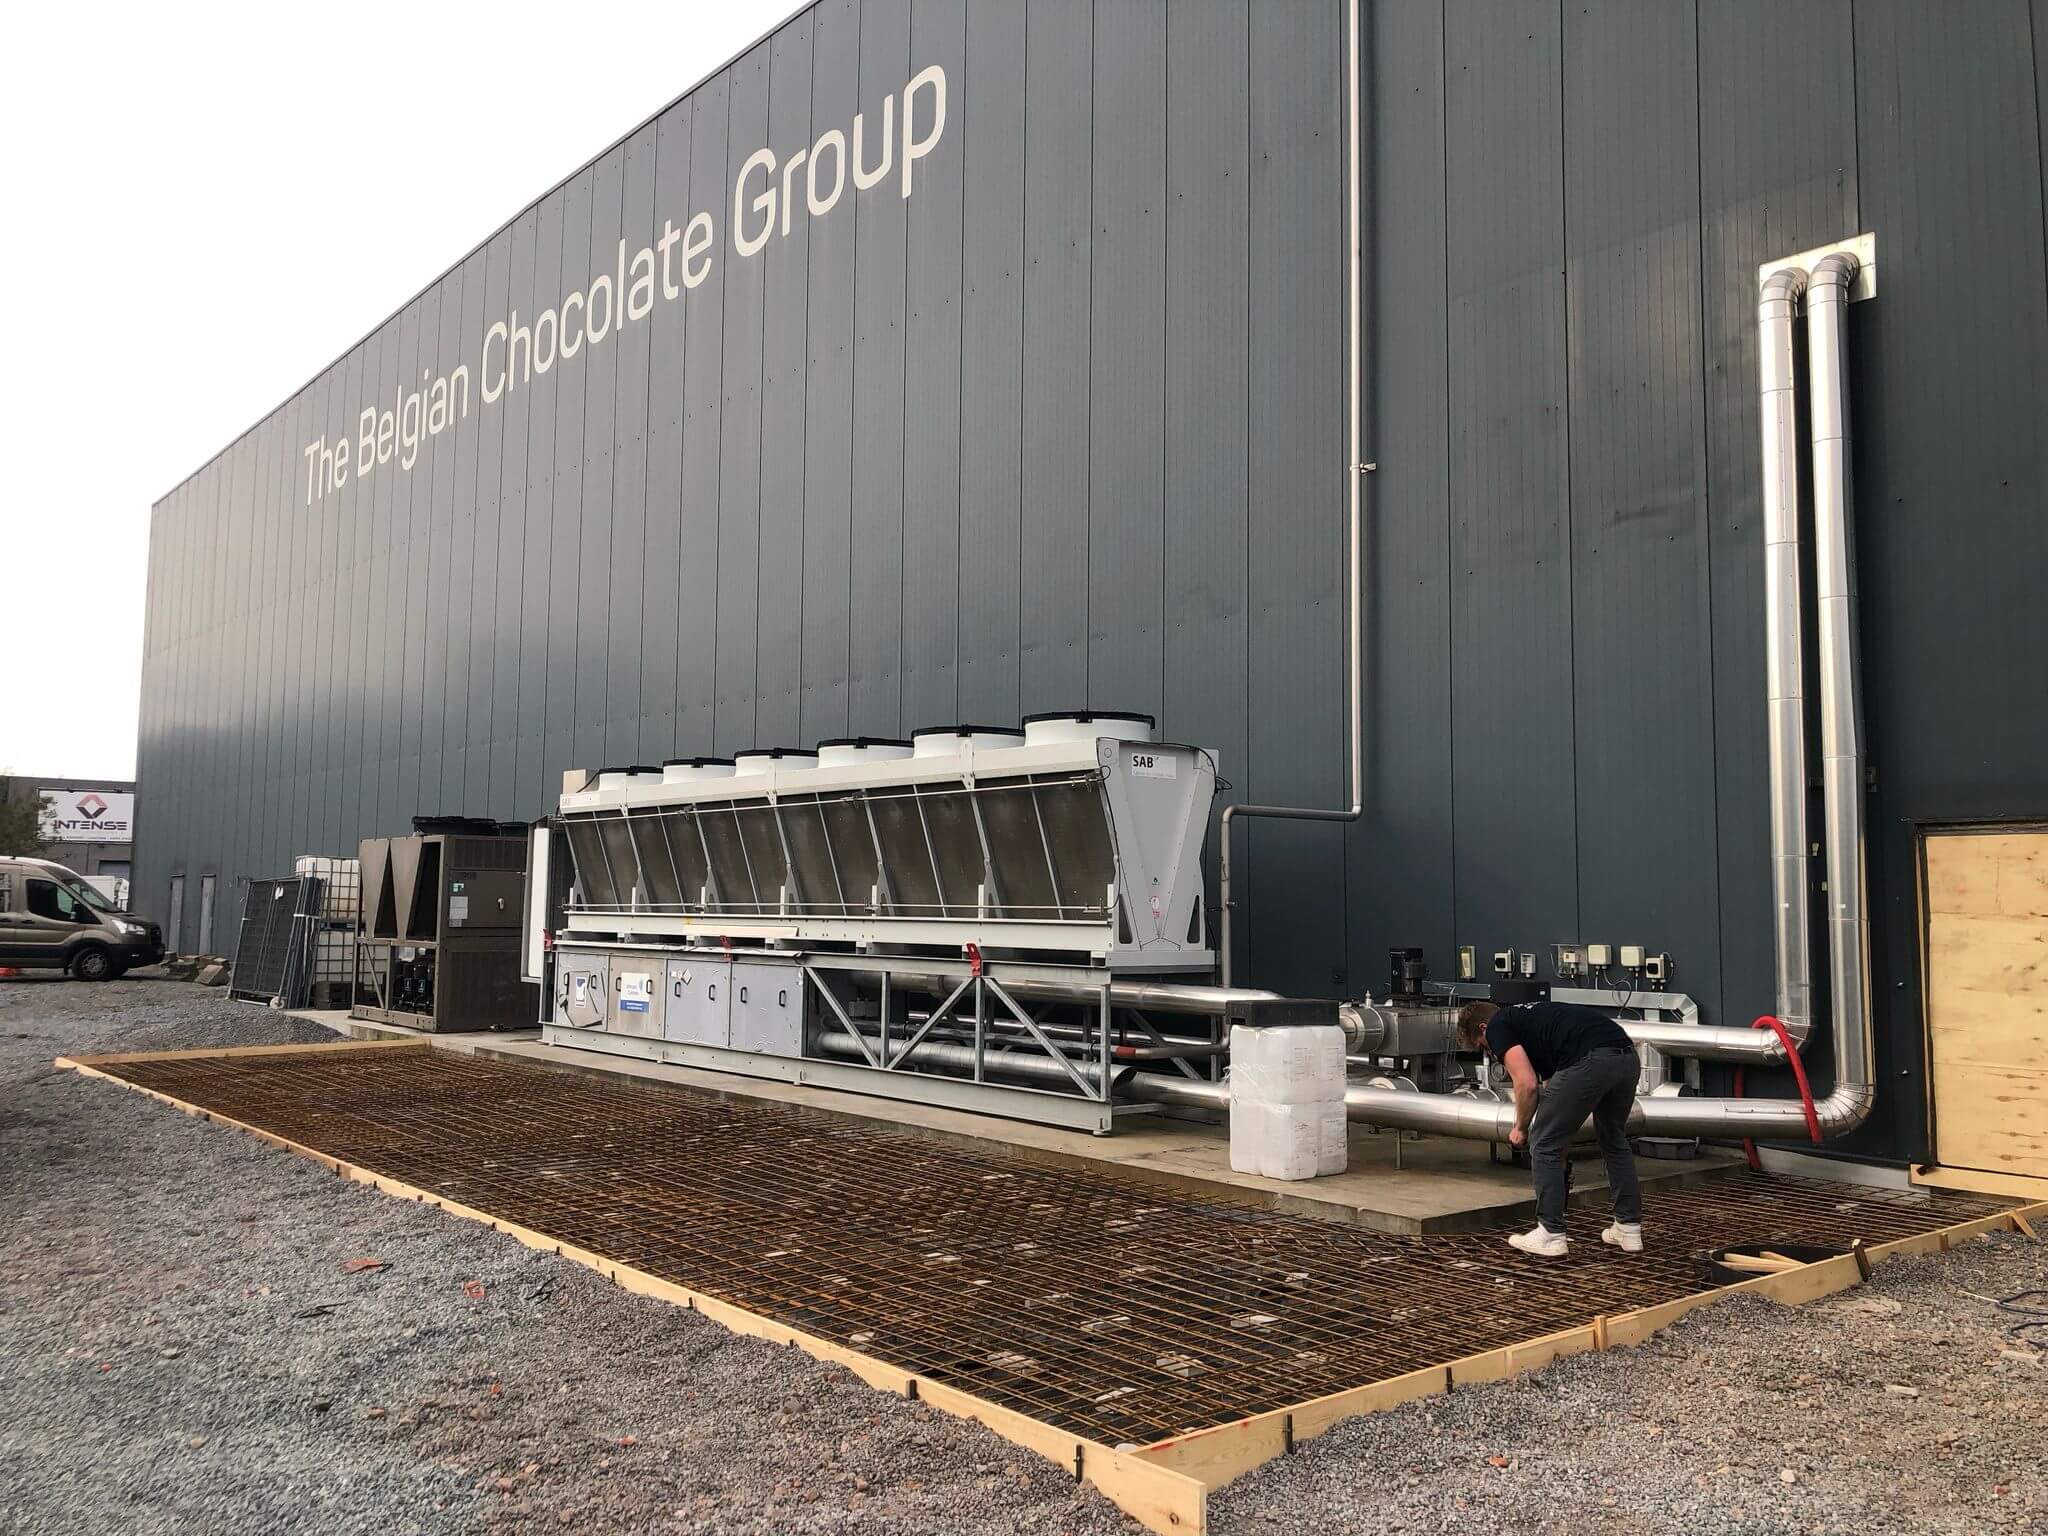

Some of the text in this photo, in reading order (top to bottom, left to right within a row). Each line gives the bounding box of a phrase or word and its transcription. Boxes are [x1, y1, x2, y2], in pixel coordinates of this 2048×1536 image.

[304, 65, 946, 506] The Belgian Chocolate Group
[1132, 755, 1154, 768] SAB
[55, 820, 127, 830] INTENSE
